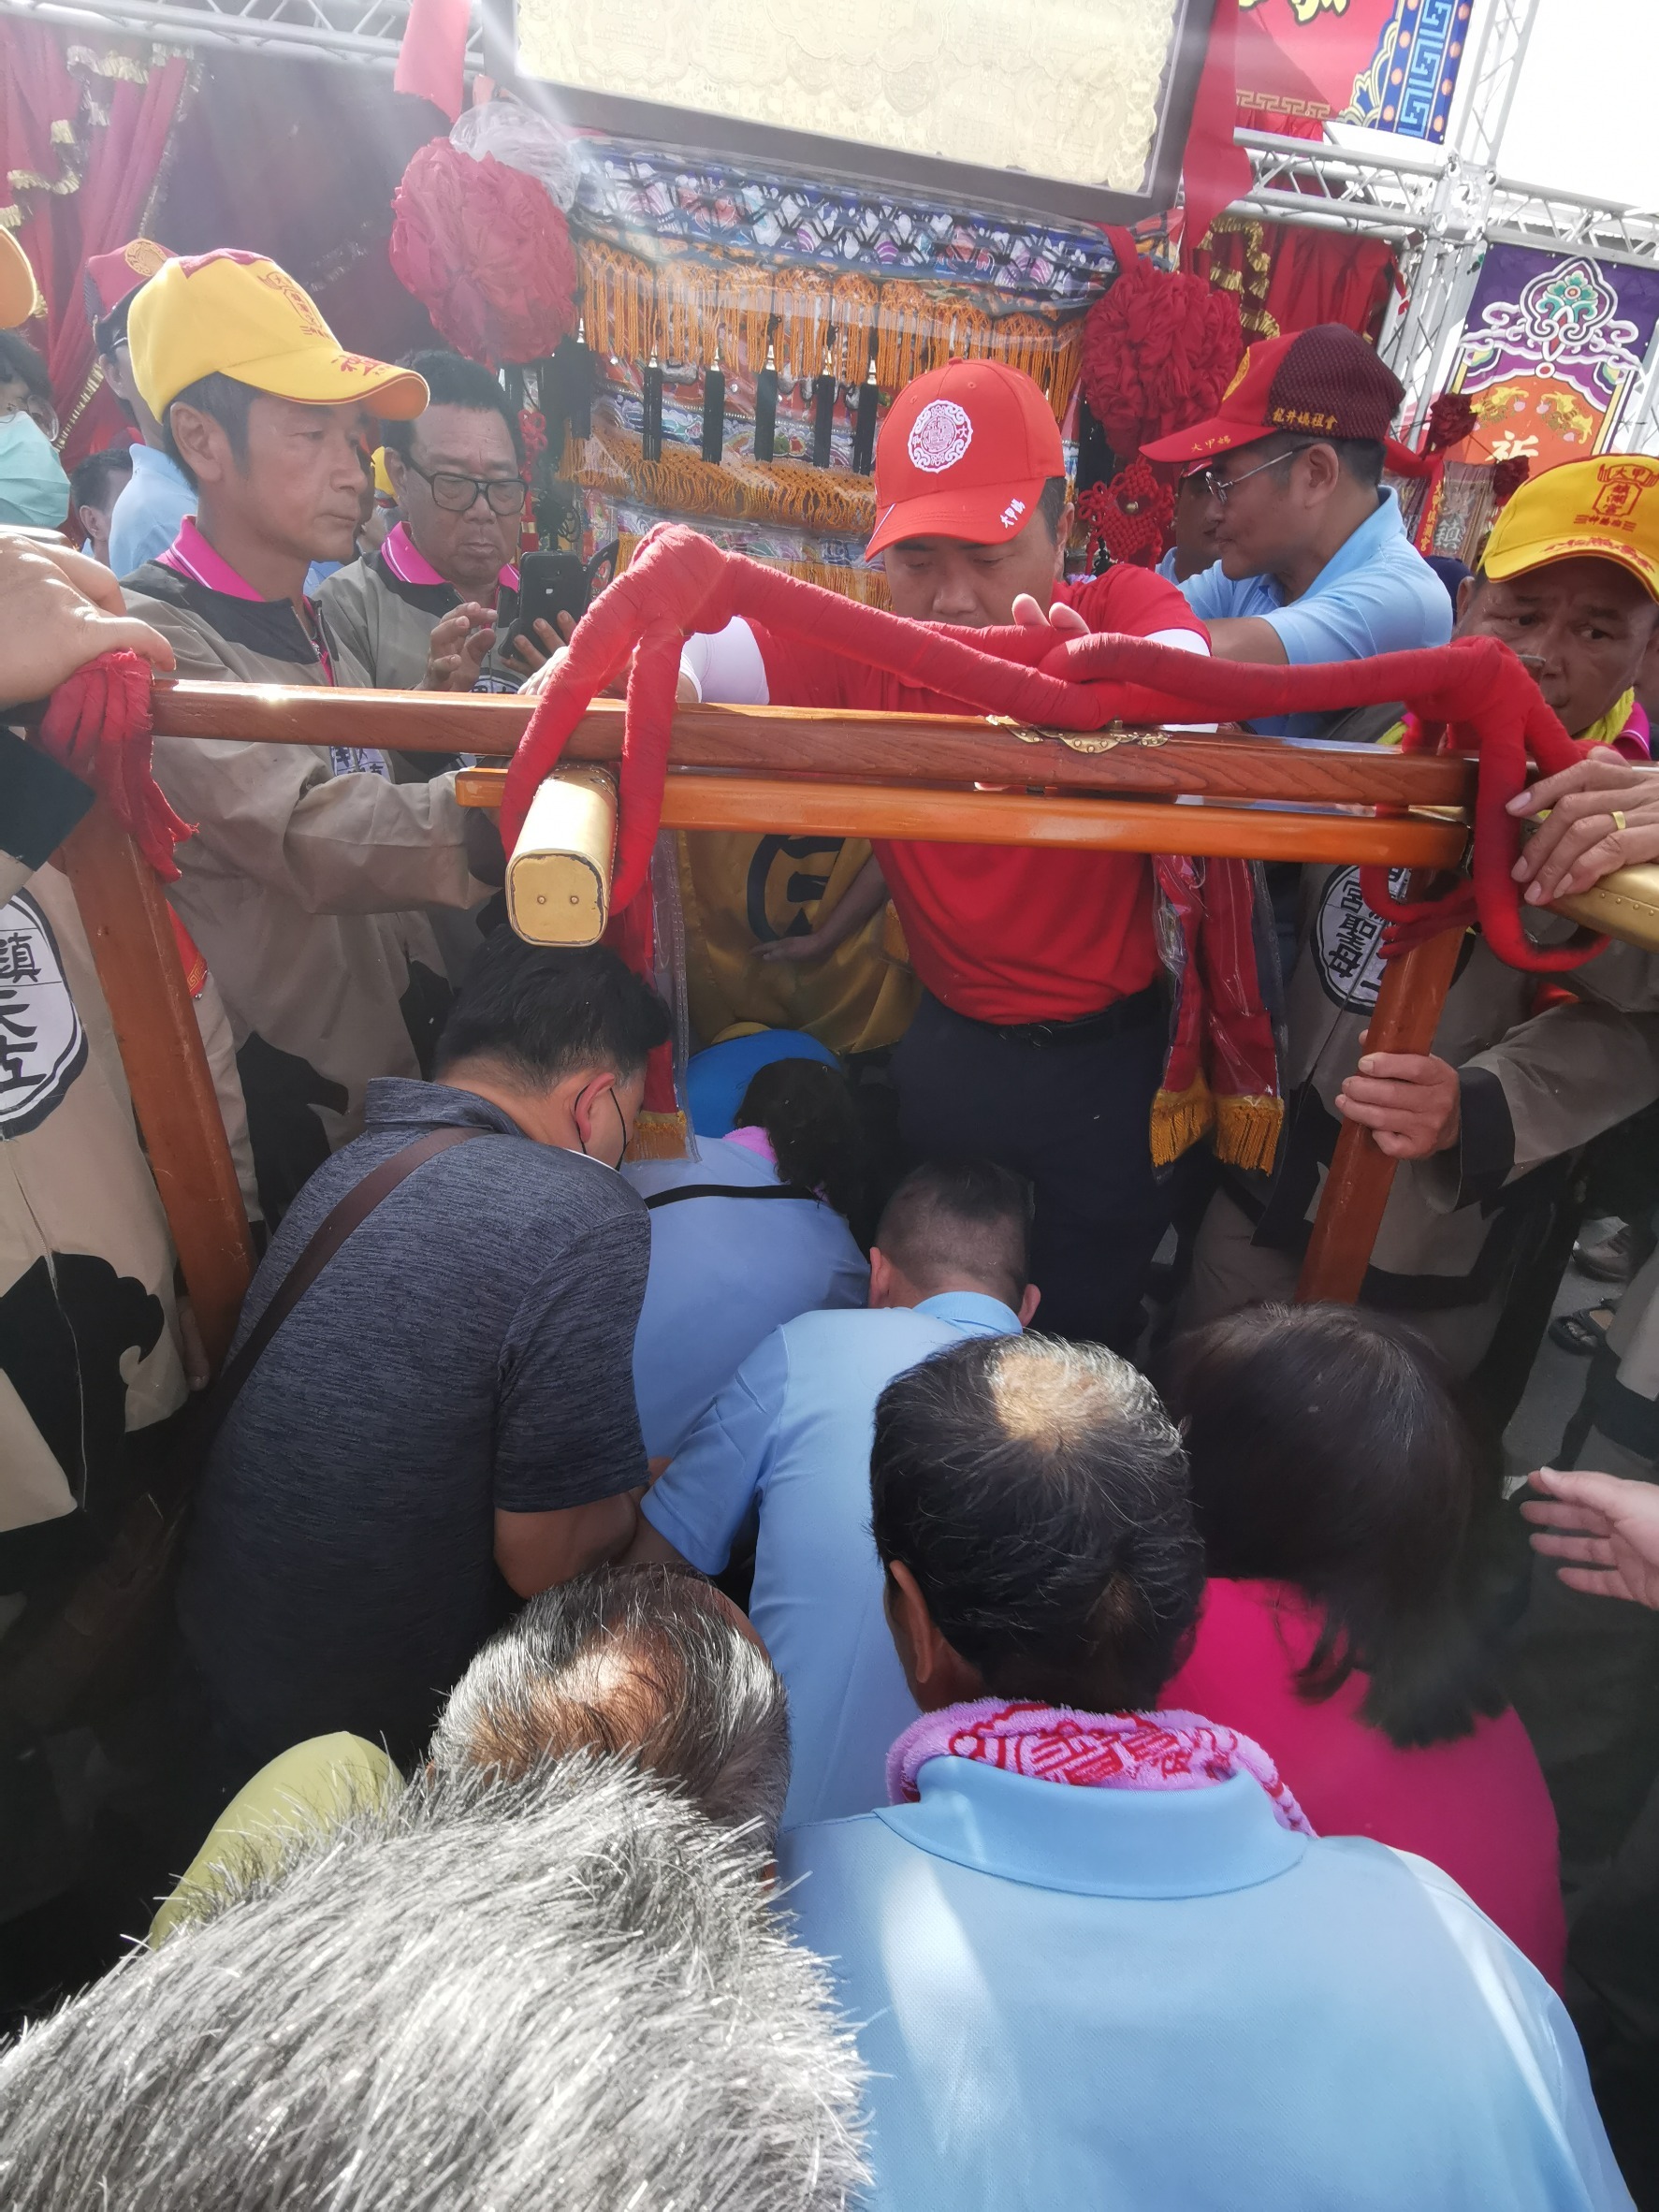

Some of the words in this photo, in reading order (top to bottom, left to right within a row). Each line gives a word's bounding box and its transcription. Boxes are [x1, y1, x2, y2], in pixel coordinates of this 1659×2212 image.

[1190, 435, 1231, 453] 大甲媽
[1615, 466, 1647, 481] 大甲
